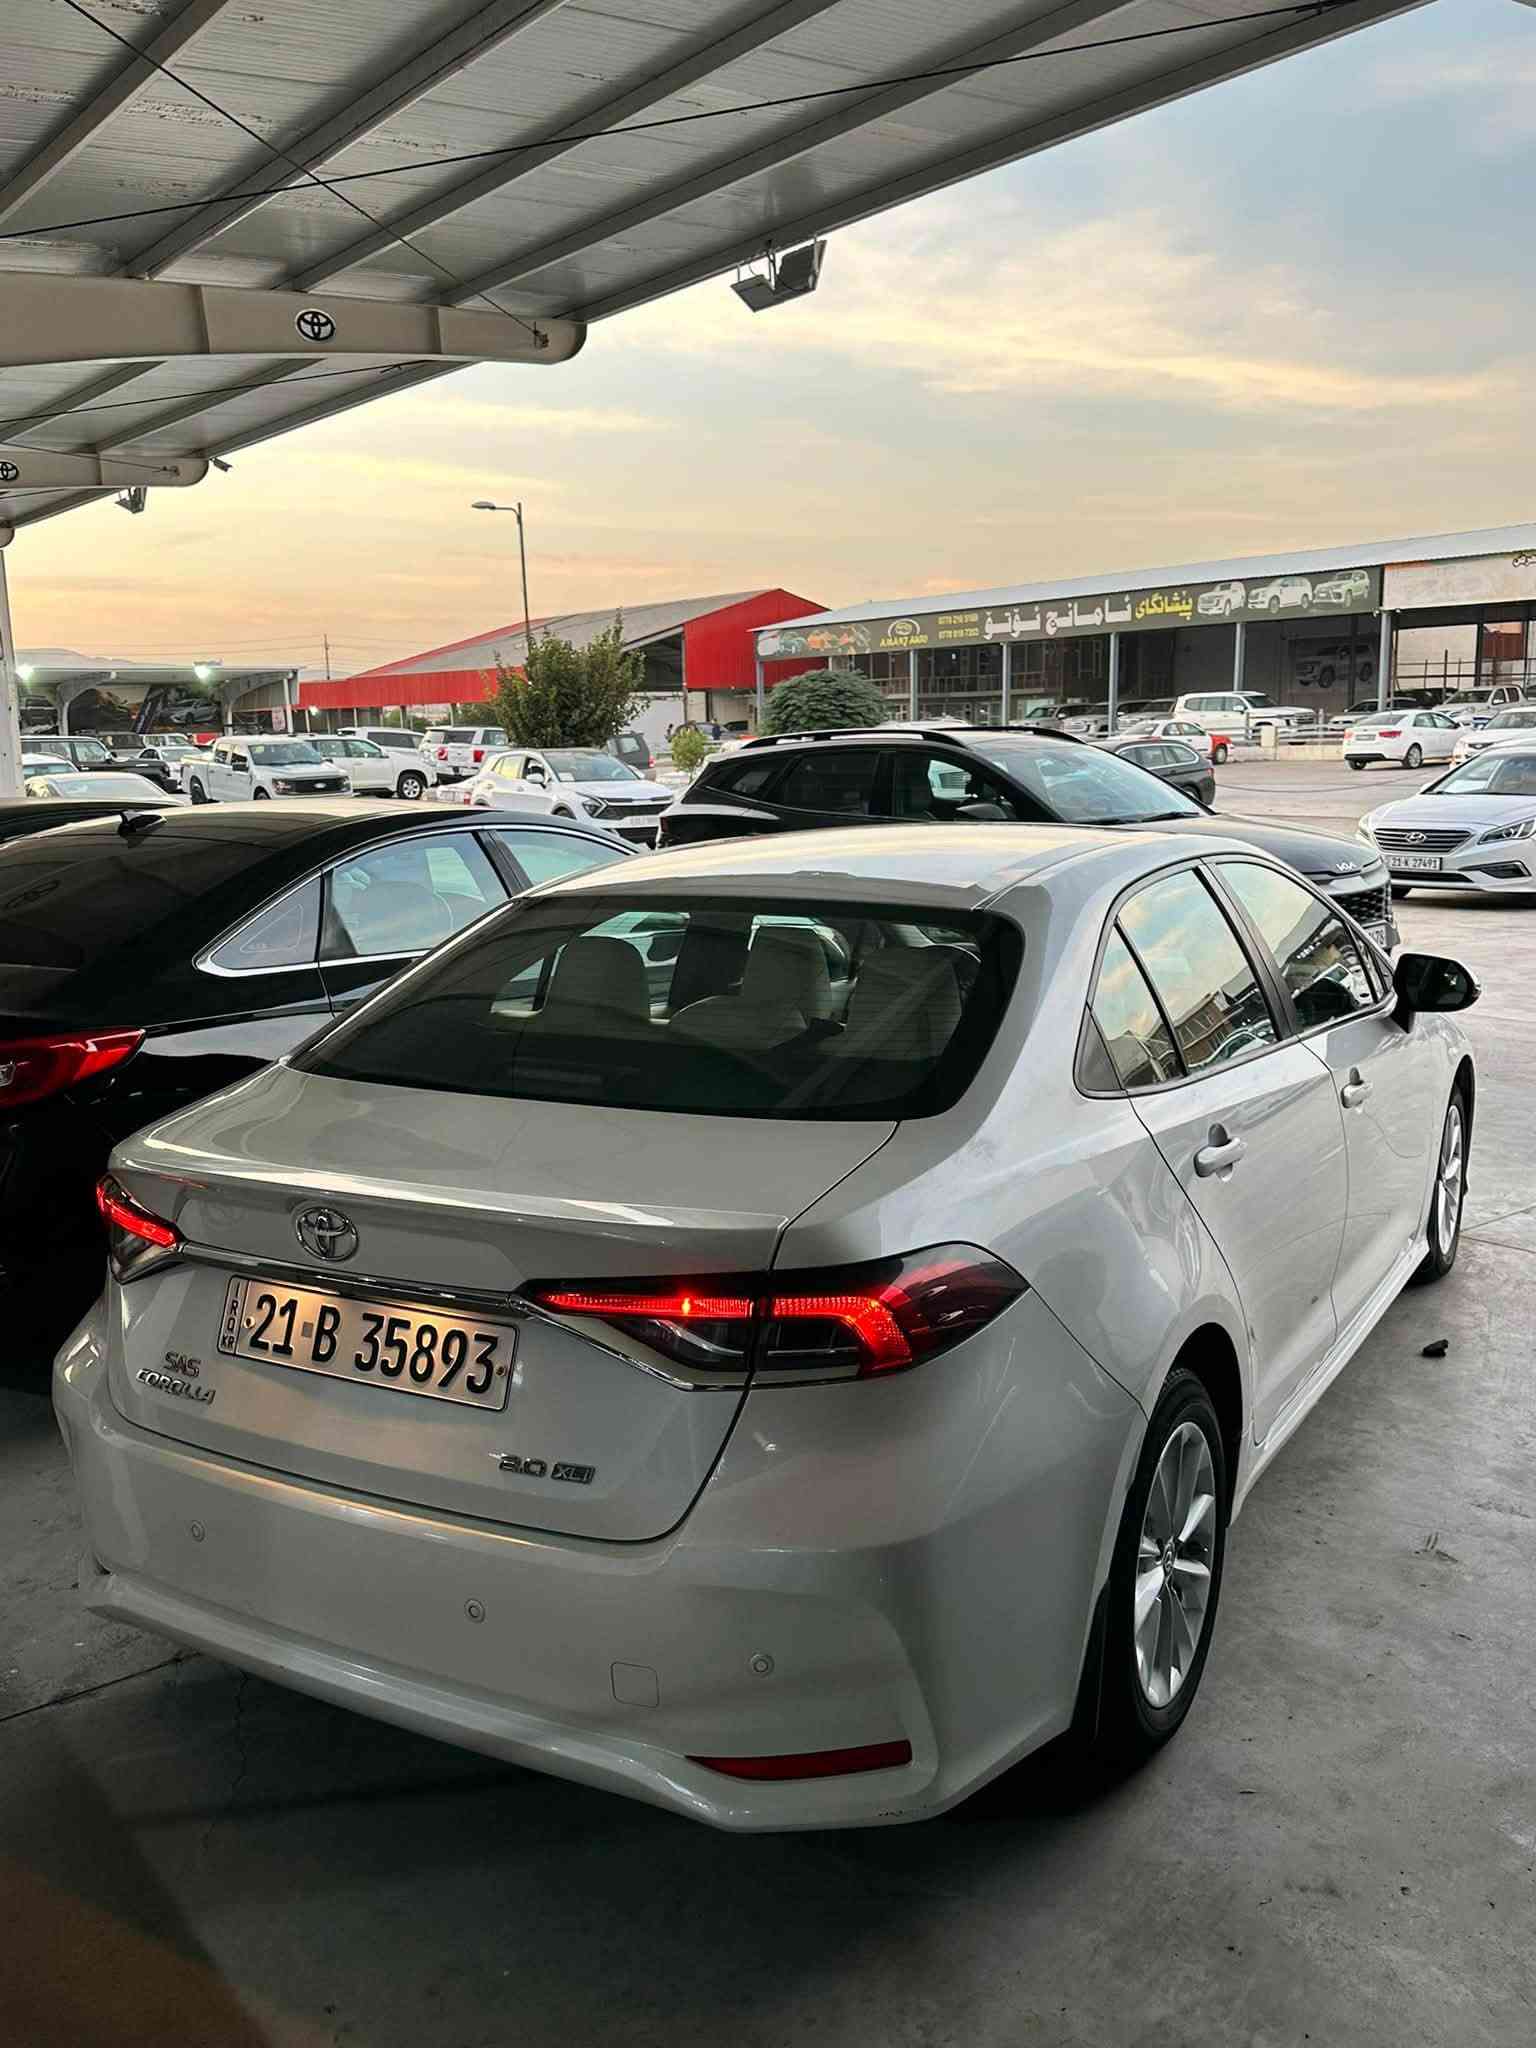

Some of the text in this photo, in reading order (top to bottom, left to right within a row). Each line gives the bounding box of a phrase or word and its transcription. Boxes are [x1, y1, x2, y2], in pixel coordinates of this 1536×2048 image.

[249, 1294, 499, 1393] 21 B 35893
[136, 1367, 216, 1405] COROLLA
